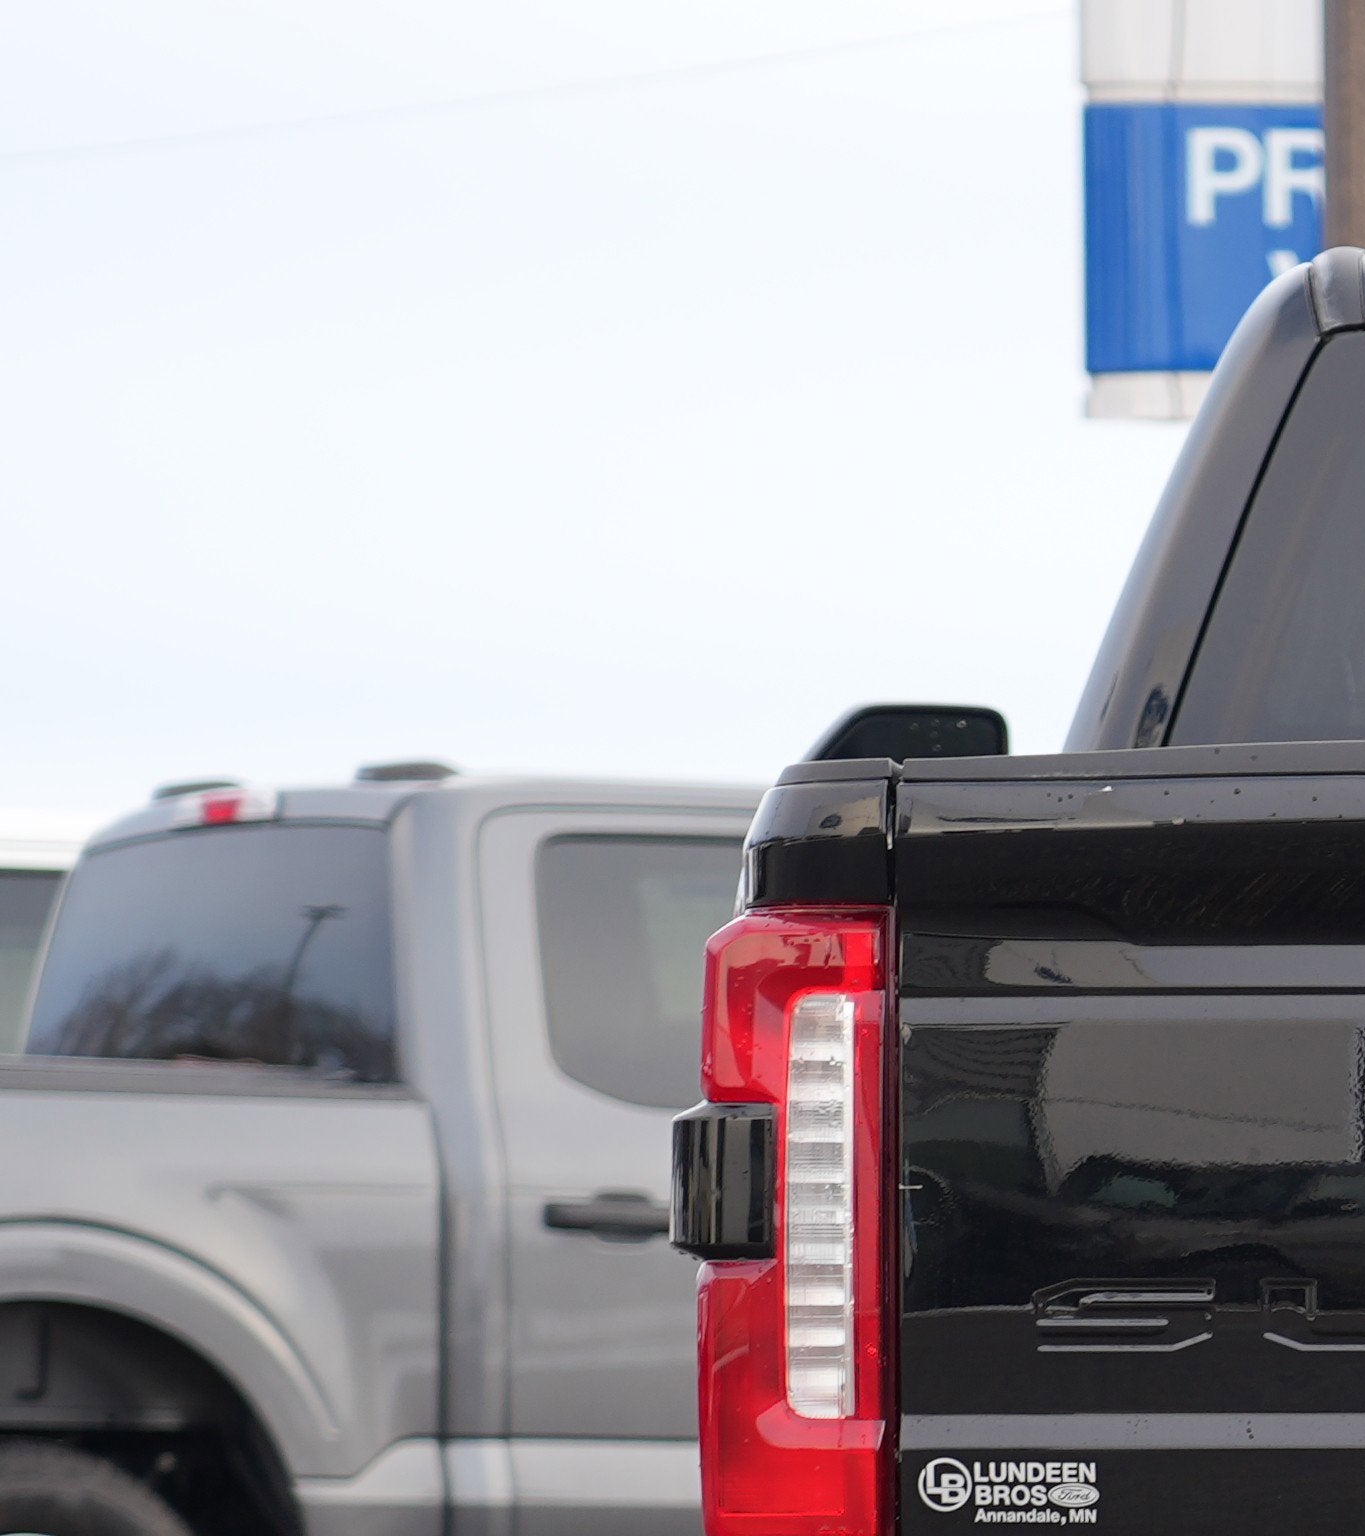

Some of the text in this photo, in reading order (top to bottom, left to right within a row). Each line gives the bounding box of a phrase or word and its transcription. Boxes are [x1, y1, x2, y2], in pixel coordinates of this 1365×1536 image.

[973, 1461, 1097, 1483] LUNDEEN
[975, 1485, 1048, 1506] BROS
[974, 1508, 1097, 1526] Annandale, MN
